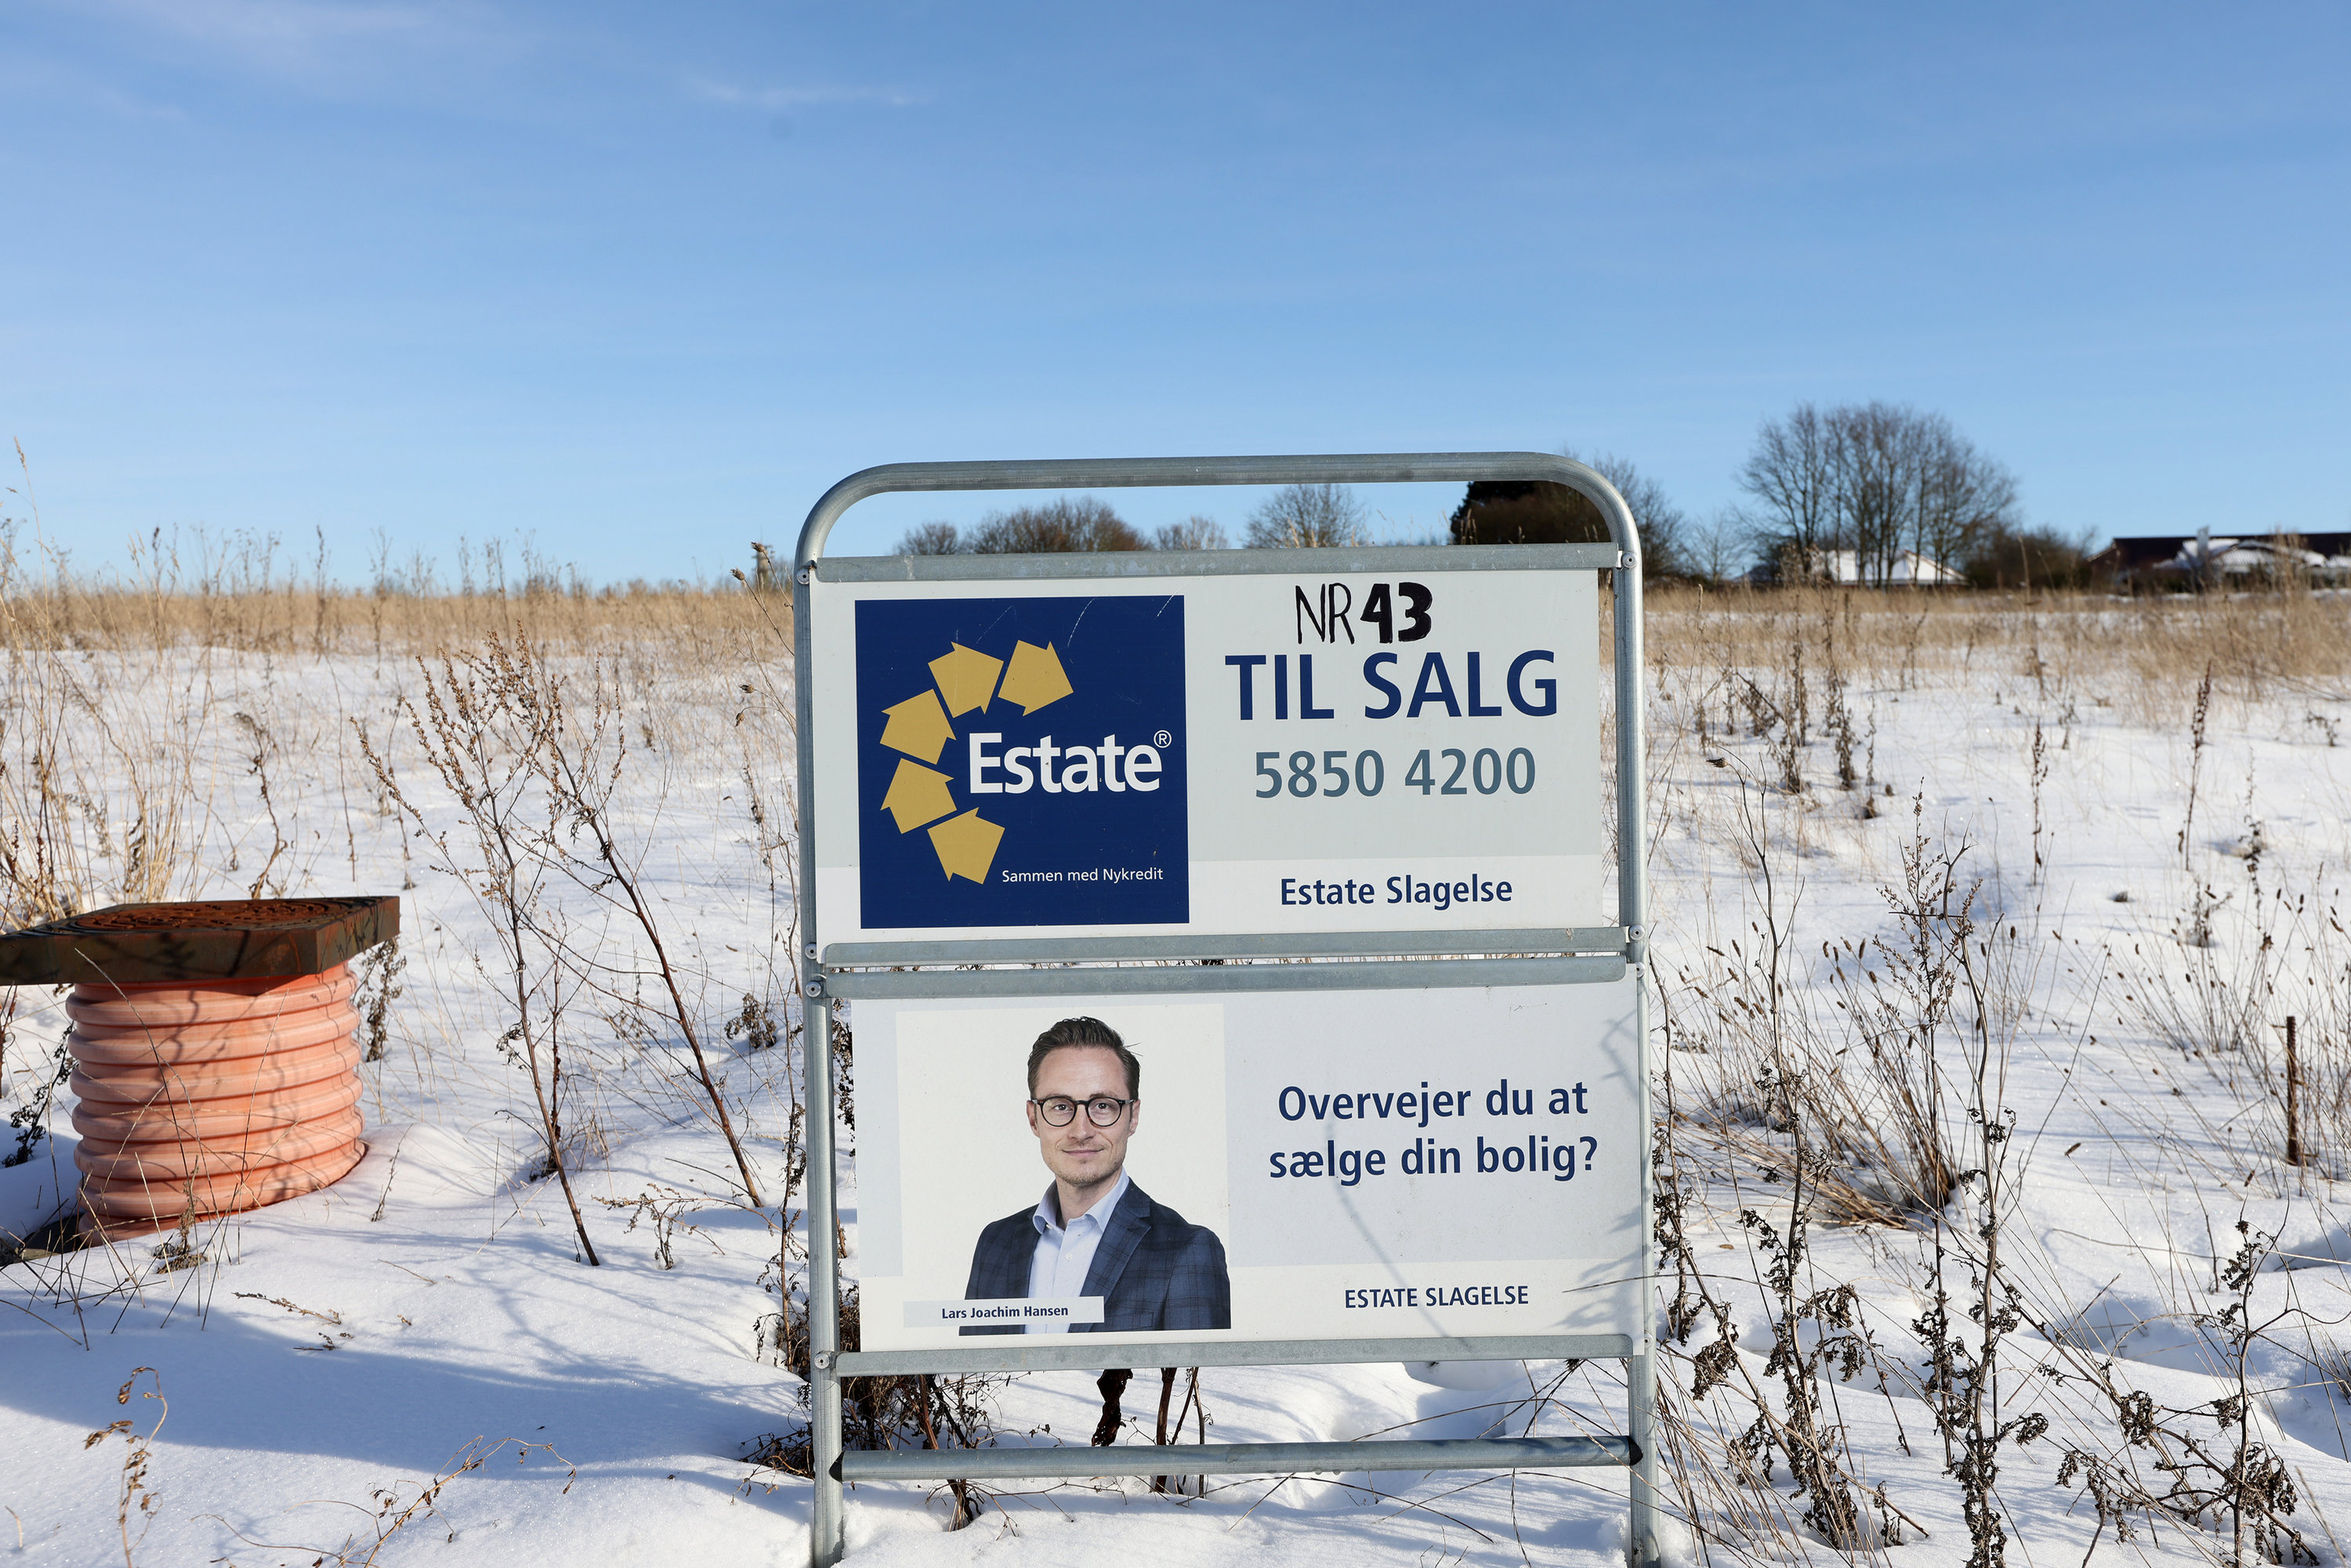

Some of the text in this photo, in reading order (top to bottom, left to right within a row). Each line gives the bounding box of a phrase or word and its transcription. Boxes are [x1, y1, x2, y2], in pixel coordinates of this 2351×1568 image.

[1295, 581, 1433, 645] NR 43
[1224, 650, 1557, 721] TIL SALG
[1255, 747, 1536, 798] 5850 4200
[1002, 867, 1164, 884] Sammen med Nykredit
[1281, 873, 1512, 911] Estate Slagelse
[1278, 1078, 1588, 1128] Overvejer du at
[1270, 1135, 1598, 1187] sælge din bolig?
[942, 1305, 1069, 1319] Lars Joachim Hansen
[1345, 1285, 1529, 1309] ESTATE SLAGELSE
